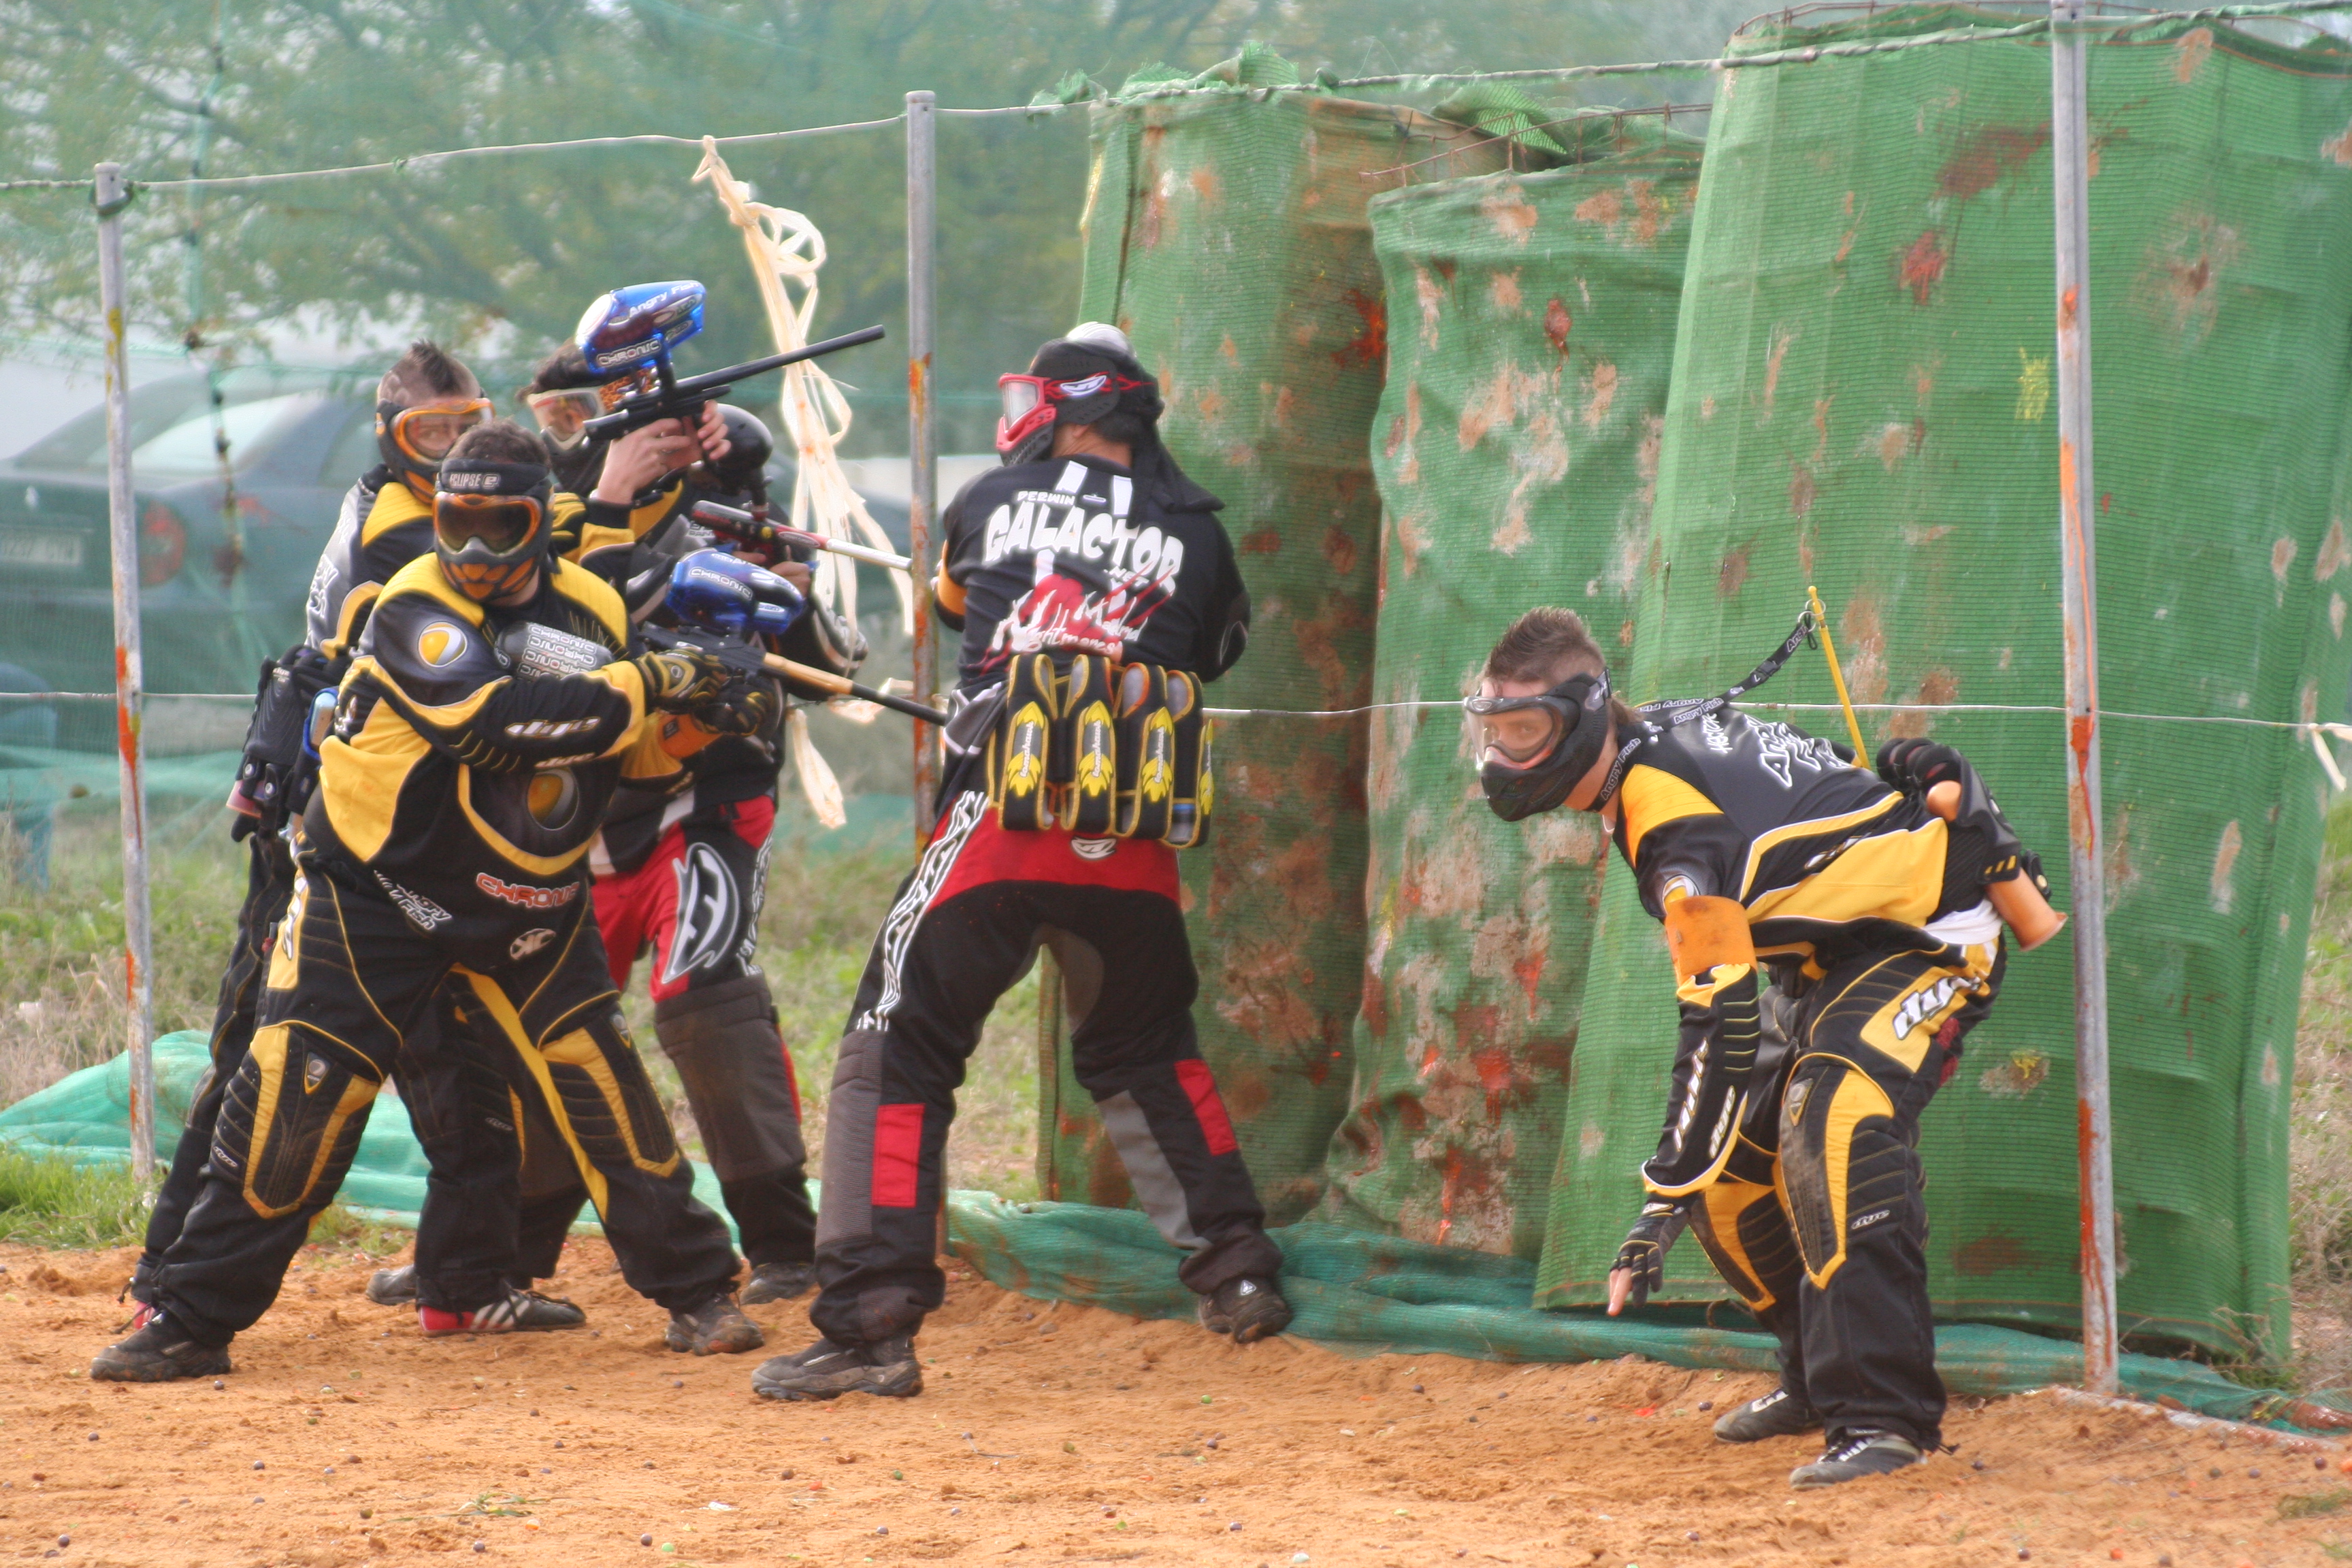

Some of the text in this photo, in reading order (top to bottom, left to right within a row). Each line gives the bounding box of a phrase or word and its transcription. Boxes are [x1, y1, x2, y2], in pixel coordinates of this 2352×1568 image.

[629, 291, 668, 317] Angry
[670, 282, 700, 295] Fish
[598, 340, 661, 365] CHRONIC
[449, 473, 482, 487] ECLIPSE
[984, 501, 1183, 596] GALACTOR
[691, 568, 751, 600] CHRONIC
[530, 625, 595, 653] CHRONIC
[524, 649, 589, 674] HRONIC
[1673, 698, 1725, 725] Angry Fish
[1600, 738, 1642, 800] Angry Fish
